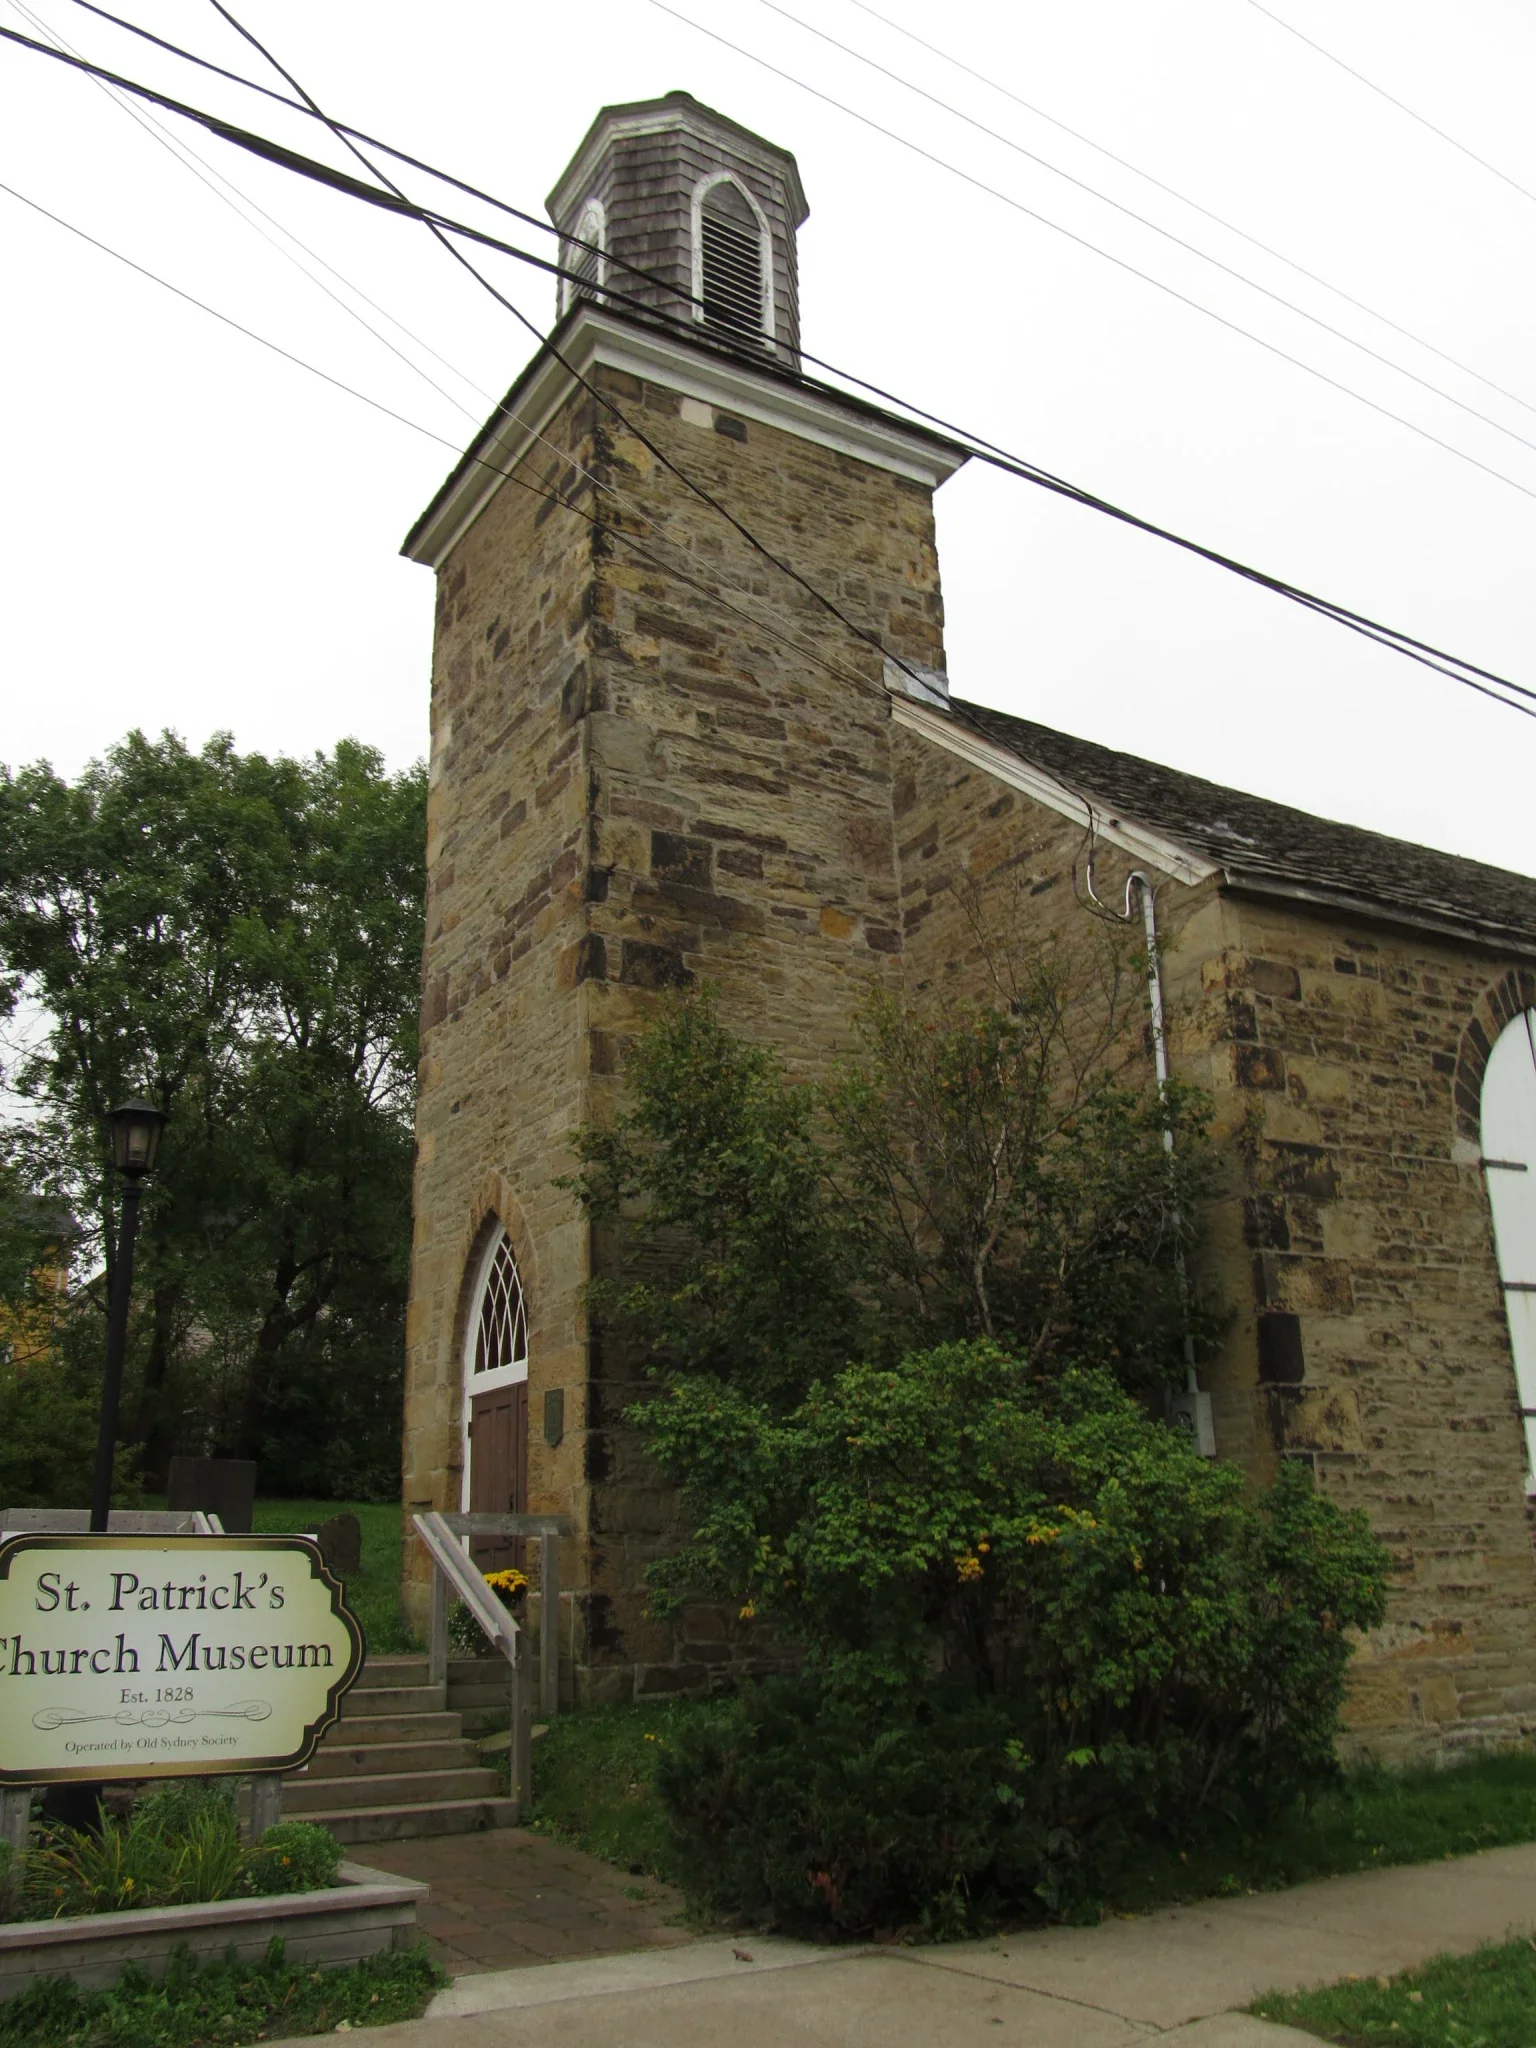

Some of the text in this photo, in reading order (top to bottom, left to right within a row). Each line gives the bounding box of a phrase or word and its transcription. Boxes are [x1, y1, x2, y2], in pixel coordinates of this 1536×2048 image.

[35, 1571, 286, 1612] St. Patrick's
[0, 1633, 334, 1676] hurch Museum
[119, 1686, 194, 1704] Est. 1828
[65, 1735, 240, 1755] Operated by Old Sydney Society
